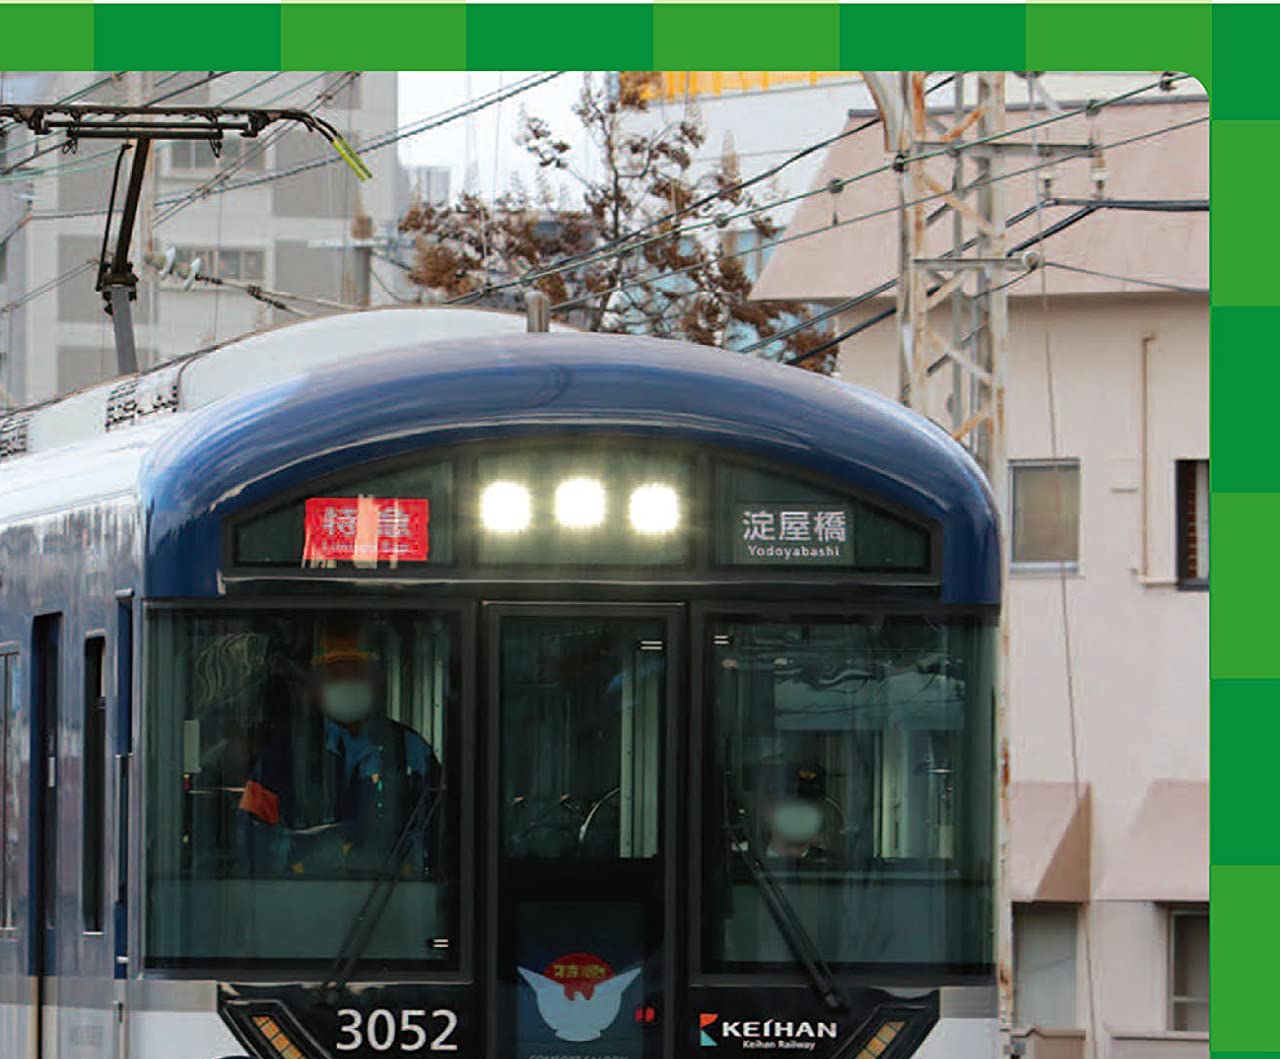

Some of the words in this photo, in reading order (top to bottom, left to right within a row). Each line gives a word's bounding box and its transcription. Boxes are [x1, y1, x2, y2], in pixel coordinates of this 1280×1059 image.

[742, 511, 847, 542] 淀屋橋
[747, 545, 840, 560] Yodoyabashi
[336, 1008, 458, 1051] 3052
[743, 1040, 776, 1049] Keihan
[778, 1040, 816, 1050] Railway
